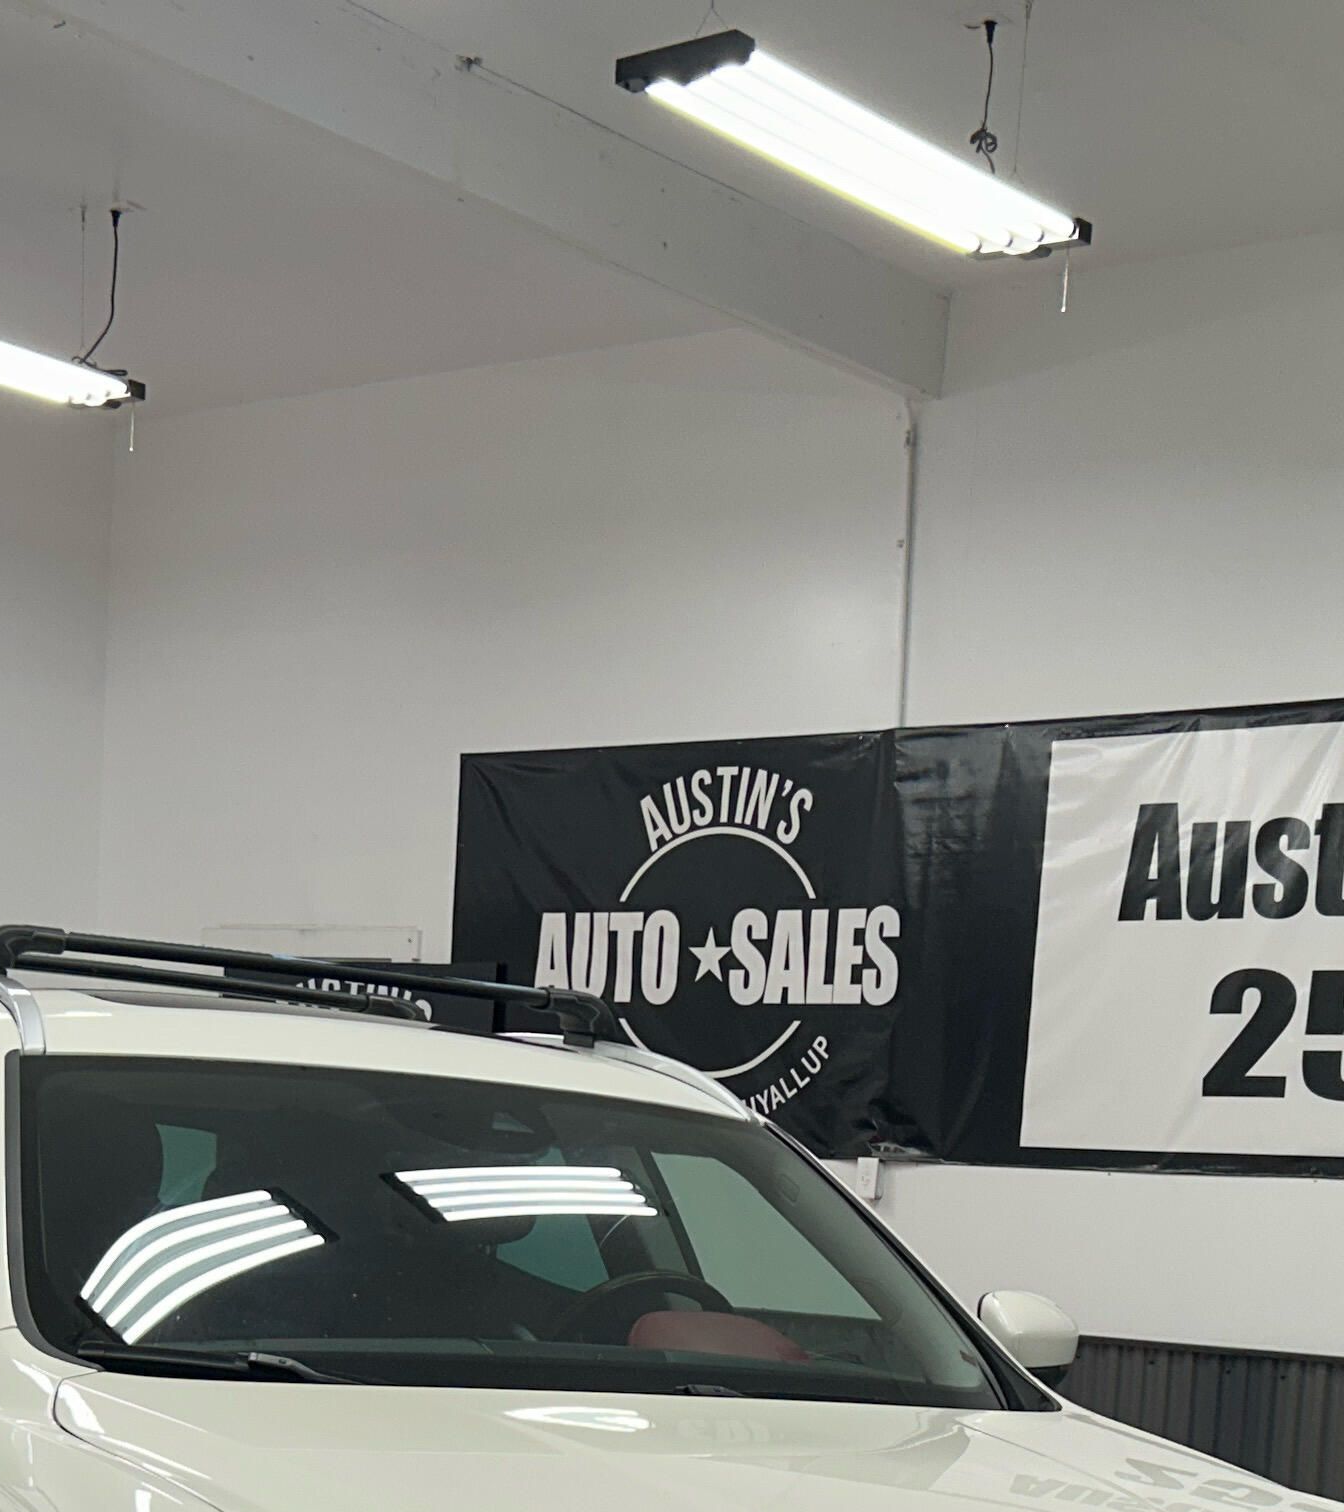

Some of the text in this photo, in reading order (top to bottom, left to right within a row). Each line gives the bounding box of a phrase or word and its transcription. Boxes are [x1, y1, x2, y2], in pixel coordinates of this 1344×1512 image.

[639, 765, 813, 852] AUSTIN'S
[534, 909, 680, 1005] AUTO
[728, 904, 901, 1006] SALES
[740, 1035, 830, 1115] YALLUP
